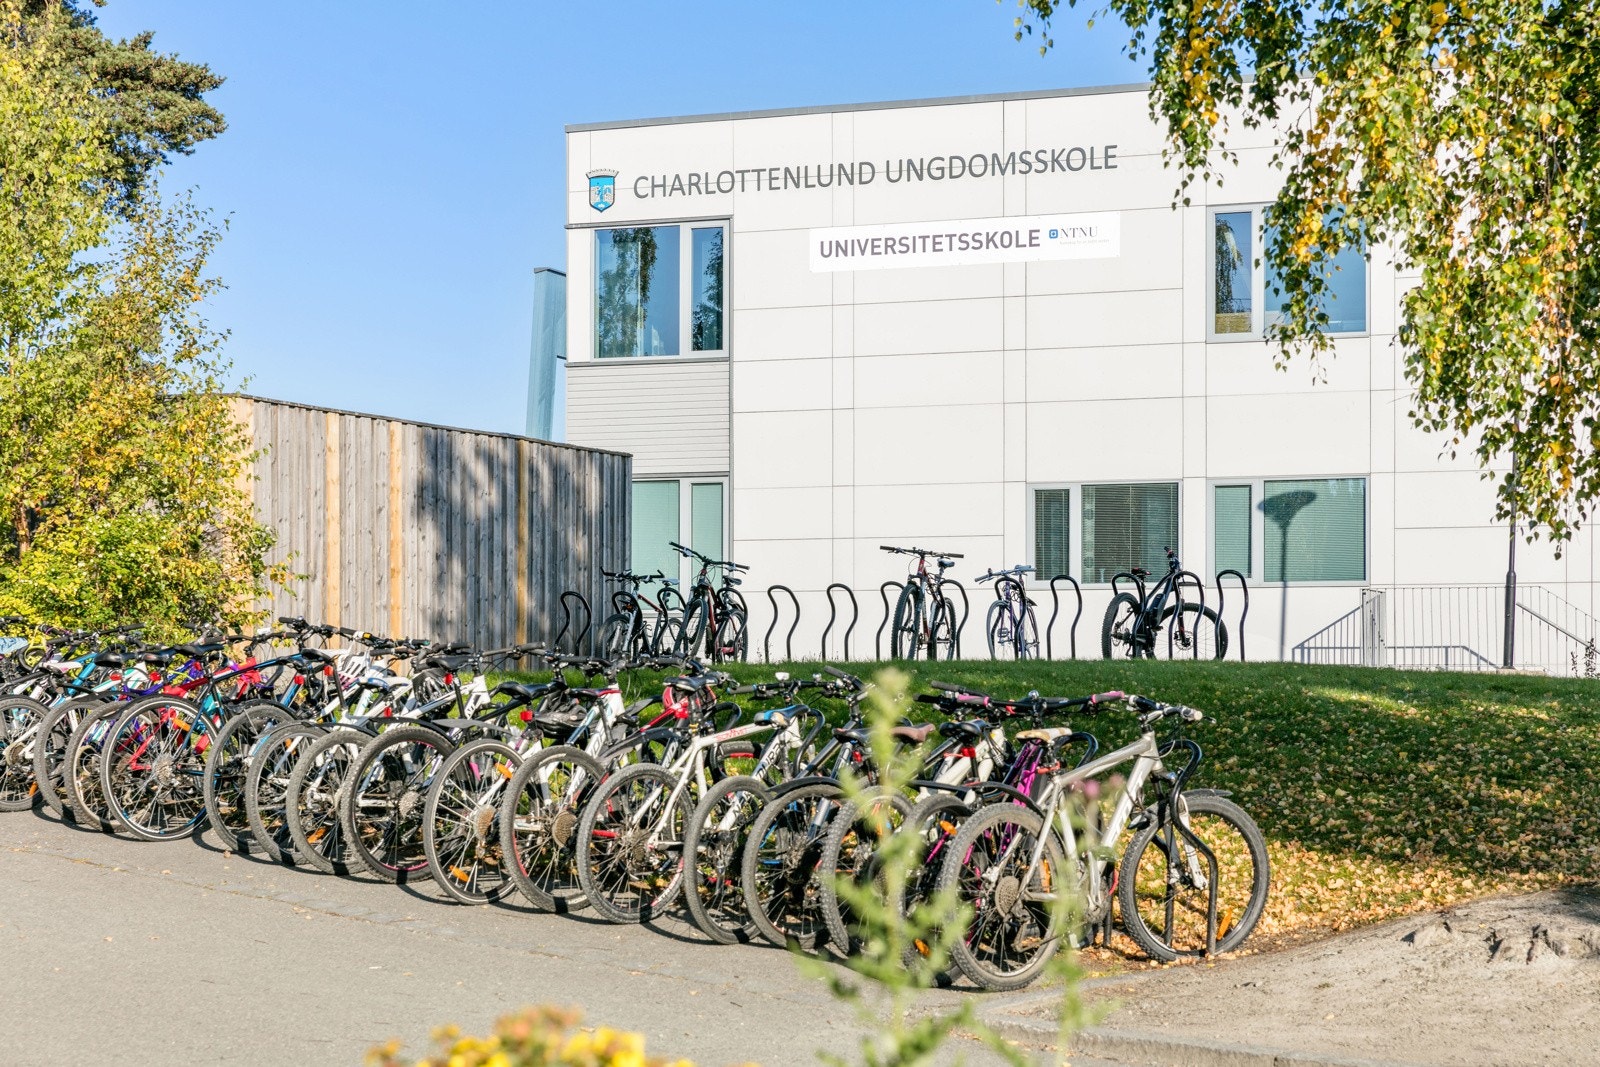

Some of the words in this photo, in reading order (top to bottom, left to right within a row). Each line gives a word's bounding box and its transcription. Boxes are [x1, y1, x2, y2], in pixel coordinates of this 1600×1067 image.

[633, 161, 876, 198] CHARLOTTENLUND
[886, 144, 1119, 184] UNGDOMSSKOLE
[820, 230, 1041, 259] UNIVERSITETSSKOLE
[1060, 226, 1099, 239] NTNU
